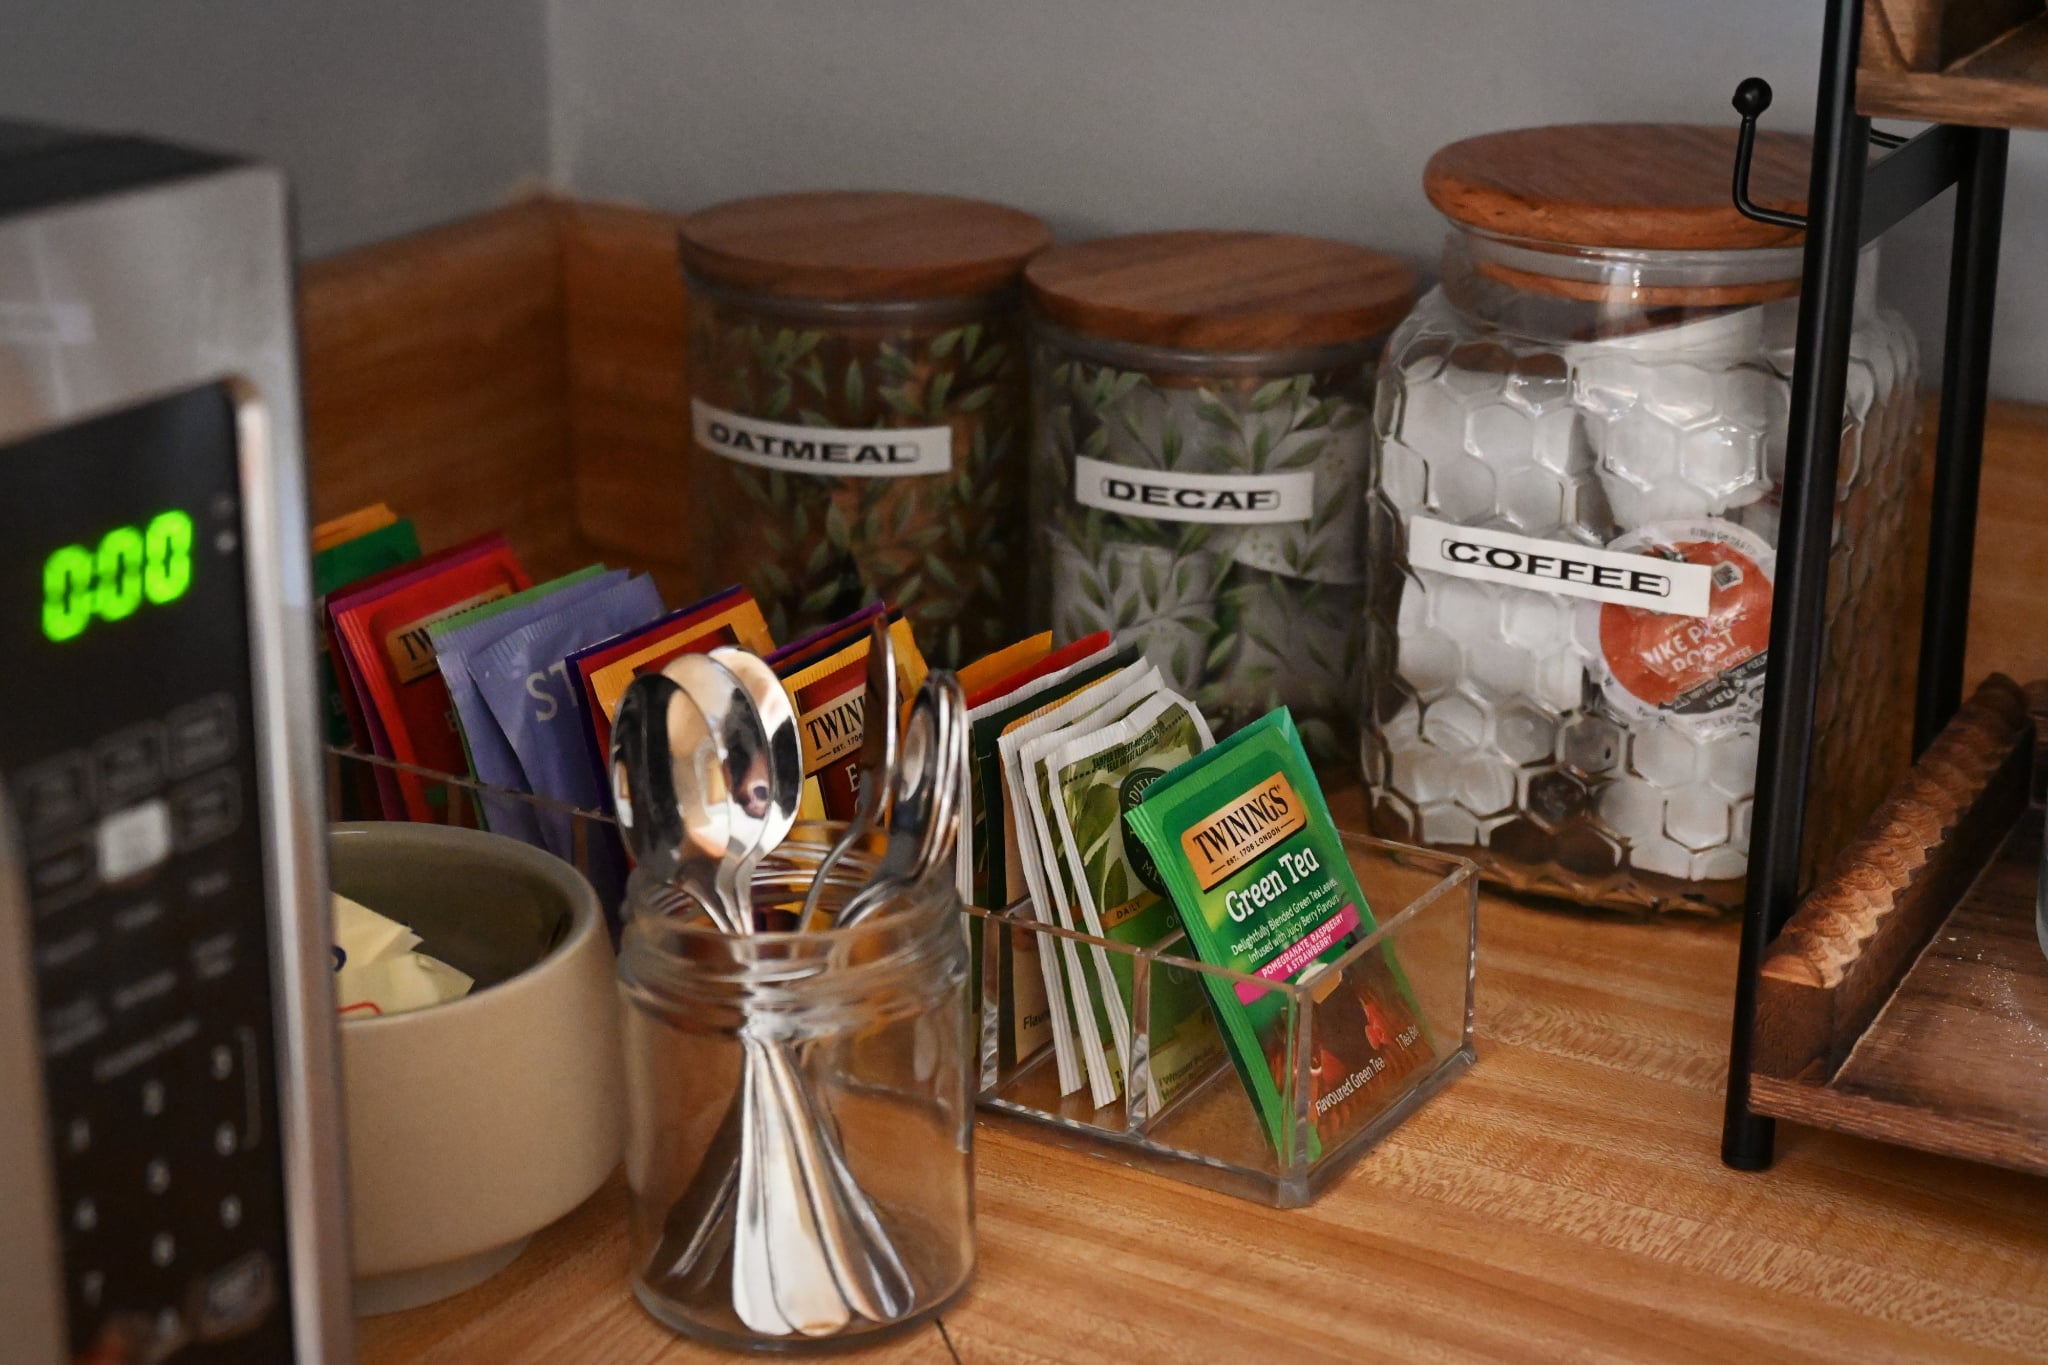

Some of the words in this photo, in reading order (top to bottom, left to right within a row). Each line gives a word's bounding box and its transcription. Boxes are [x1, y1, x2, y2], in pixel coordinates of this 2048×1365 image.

[708, 421, 917, 464] OATMEAL
[1107, 479, 1275, 511] DECAF
[42, 509, 192, 642] 0:00
[1448, 541, 1663, 597] COFFEE
[1192, 784, 1289, 864] TWININGS
[1254, 826, 1282, 847] LONDON
[1116, 901, 1142, 920] DAILY
[1225, 869, 1288, 923] Green
[1278, 847, 1320, 885] Tea
[1231, 922, 1271, 956] Delightfully
[1267, 908, 1295, 932] Blended
[1292, 896, 1312, 918] Green
[1309, 888, 1322, 902] Tea
[1248, 941, 1274, 963] Infused
[1272, 932, 1288, 950] with
[1287, 921, 1303, 939] Juicy
[1300, 911, 1319, 930] Berry
[1261, 935, 1312, 979] POMEGRANATE,
[1310, 914, 1345, 945] RASPBERRY
[1286, 964, 1293, 974] &
[1291, 935, 1333, 971] STRAWBERRY
[1315, 1078, 1355, 1117] Flavoured
[1350, 1065, 1375, 1089] Green
[1369, 1056, 1386, 1074] Tea
